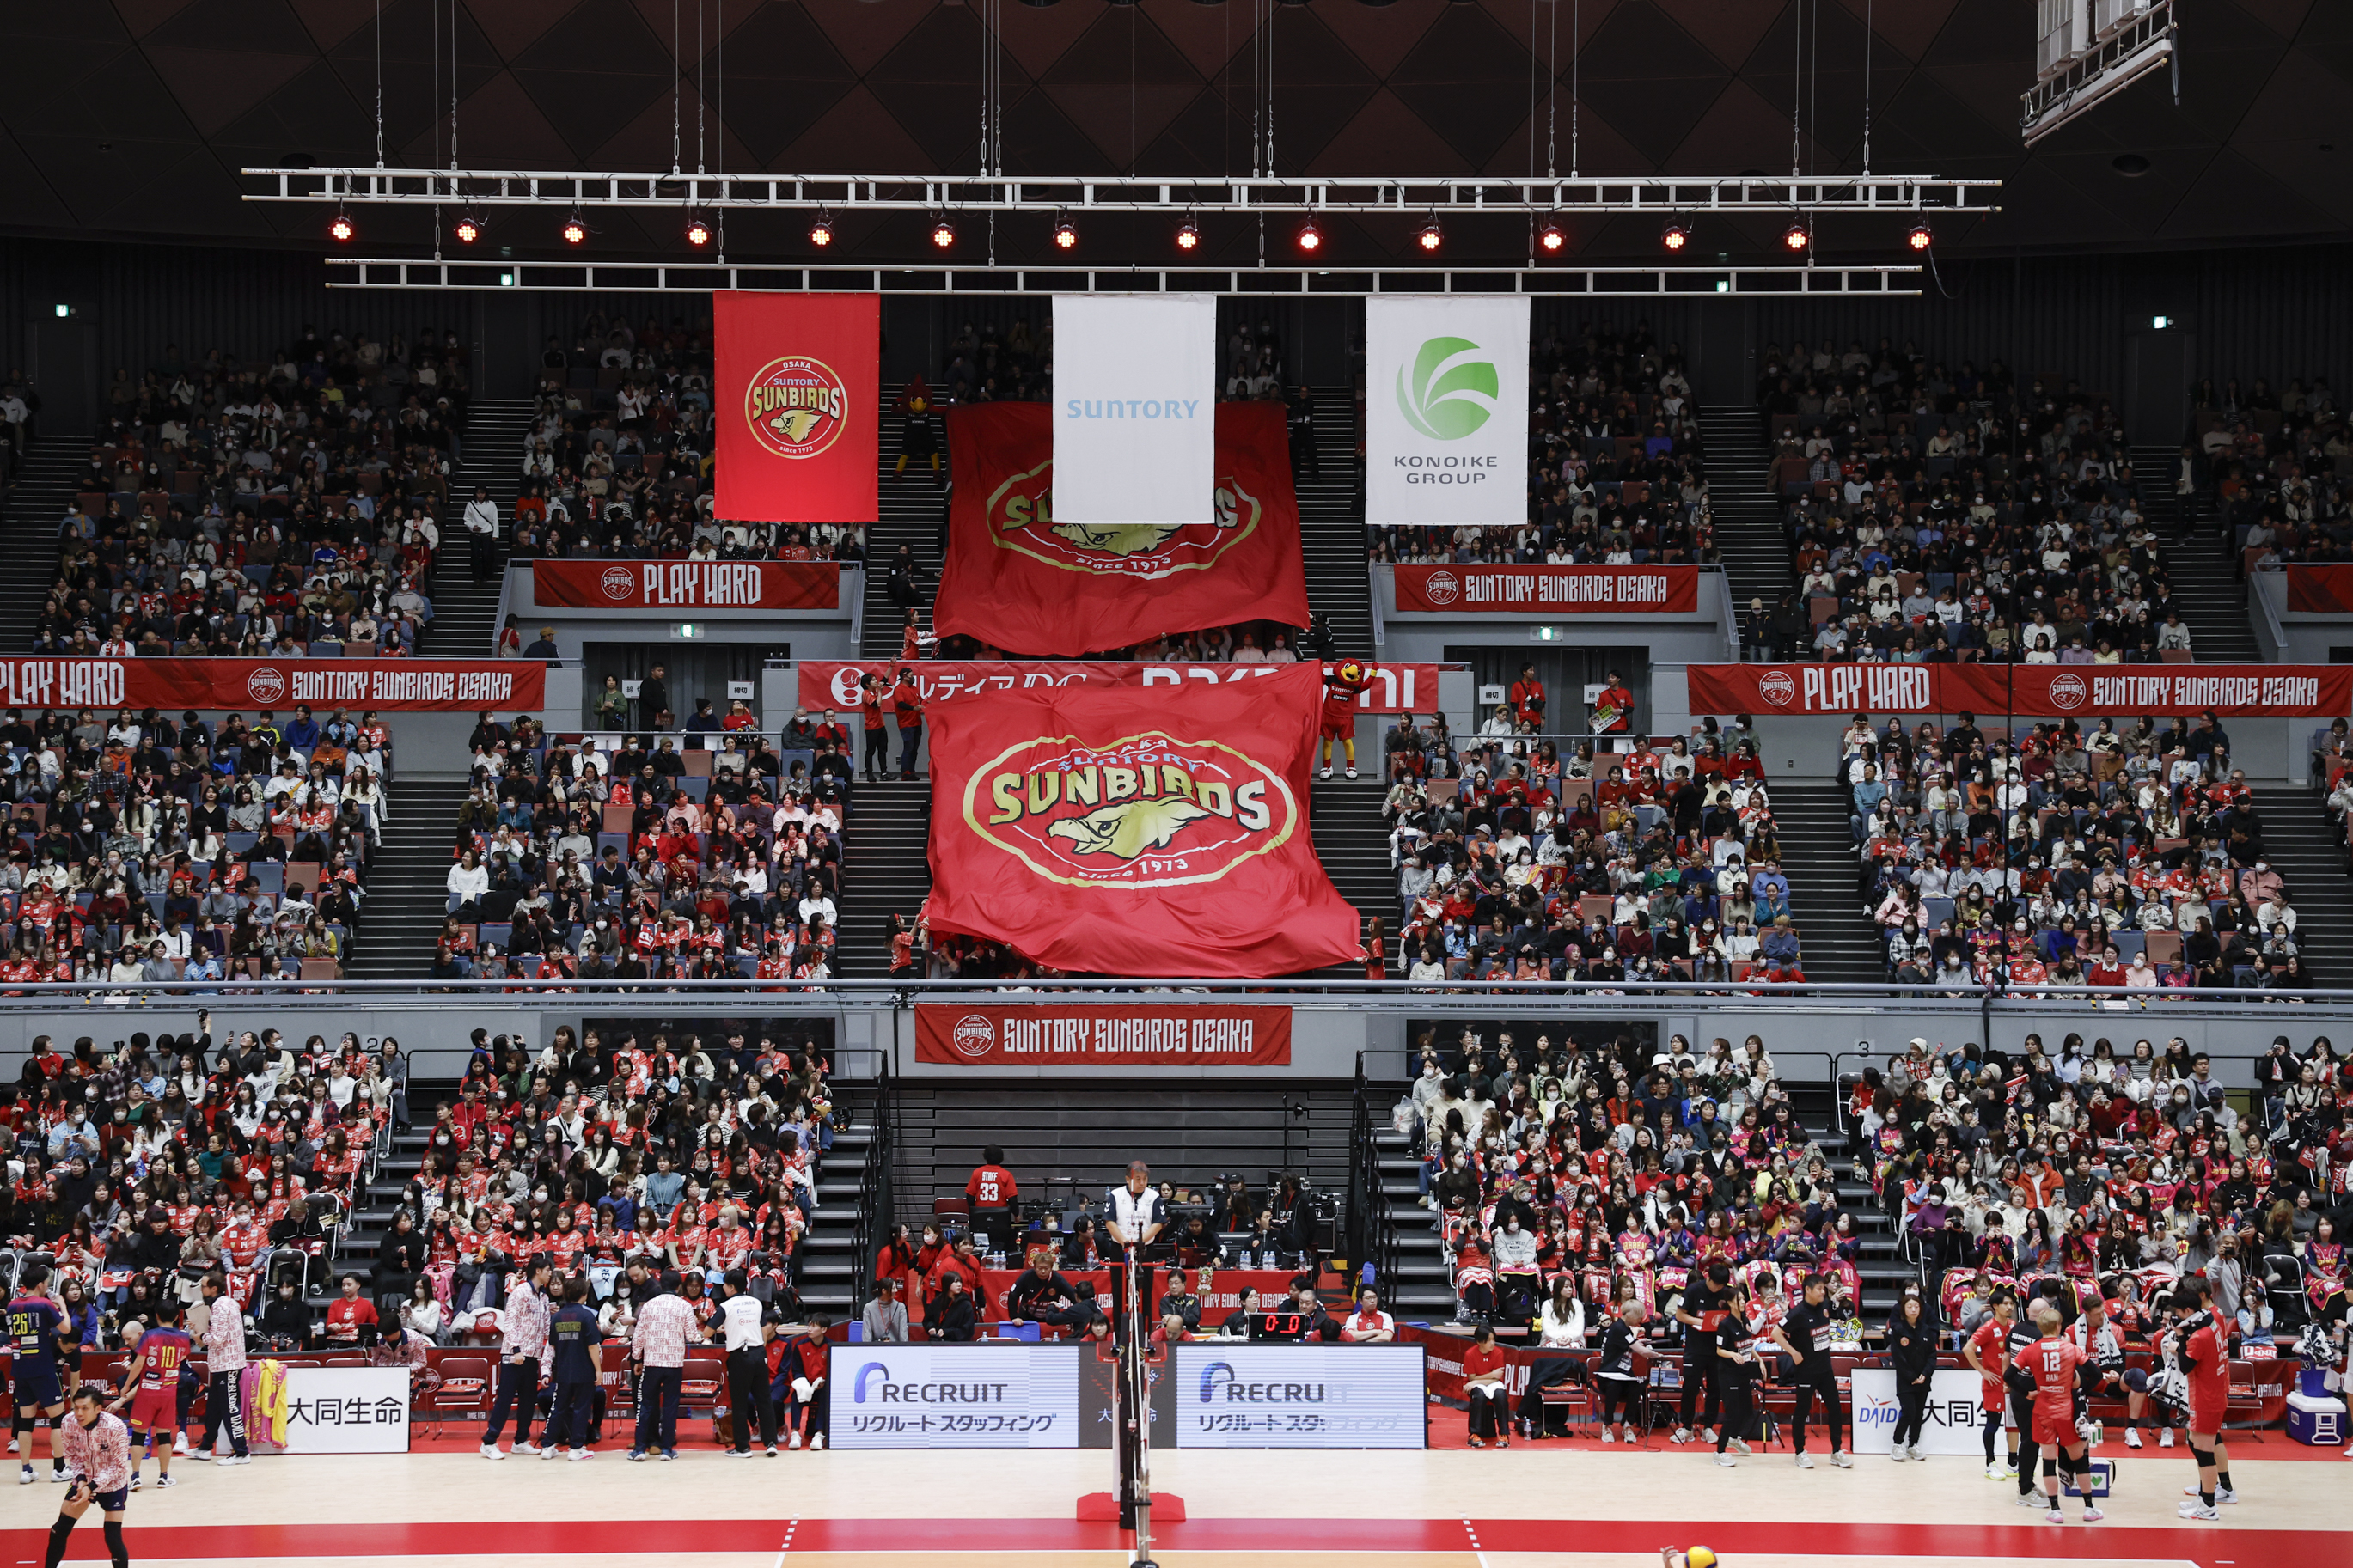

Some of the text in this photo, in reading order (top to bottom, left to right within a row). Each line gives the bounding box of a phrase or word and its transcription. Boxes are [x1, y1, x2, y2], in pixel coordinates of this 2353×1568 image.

[782, 360, 812, 369] OSAKA
[773, 377, 820, 386] SUNTORY
[752, 387, 840, 421] SUNBIRDS
[1066, 399, 1200, 419] SUNTORY
[779, 445, 814, 454] since 1973
[1393, 455, 1498, 467] KONOIKE
[1406, 473, 1487, 485] GROUP
[1075, 556, 1171, 572] since 1973
[603, 576, 633, 587] SUNBIRDS
[643, 564, 761, 605] PLAY HARD
[1427, 581, 1457, 592] SUNBIRDS
[1465, 575, 1667, 602] SUNTORY SUNBIRDS OSAKA
[59, 662, 125, 705] HARD
[250, 678, 283, 690] SUNBIRDS
[291, 670, 513, 701] SUNTORY SUNBIRDS OSAKA
[1762, 681, 1793, 693] SUNBIRDS
[1803, 666, 1931, 711] PLAY HARD
[2051, 684, 2084, 697] SUNBIRDS
[2093, 676, 2319, 706] SUNTORY SUNBIRDS OSAKA
[1058, 753, 1202, 773] SUNTORY
[989, 764, 1272, 832] SUNBIRDS
[1077, 857, 1189, 881] since 1973
[956, 1027, 992, 1041] SUNBIRDS
[1003, 1018, 1254, 1053] SUNTORY SUNBIRDS OSAKA
[366, 1036, 379, 1051] 2
[1858, 1040, 1870, 1058] 3
[981, 1170, 999, 1181] STAFF
[979, 1182, 999, 1202] 33
[2108, 1254, 2130, 1270] 31
[12, 1312, 28, 1335] 26
[1264, 1315, 1277, 1333] 0
[2011, 1332, 2037, 1344] SUNTORY
[160, 1345, 176, 1368] 10
[2042, 1351, 2061, 1373] 12
[2045, 1374, 2059, 1382] RAN
[881, 1383, 1009, 1403] RECRUIT
[2258, 1382, 2283, 1398] OSAKA
[286, 1395, 403, 1427] 大同生命
